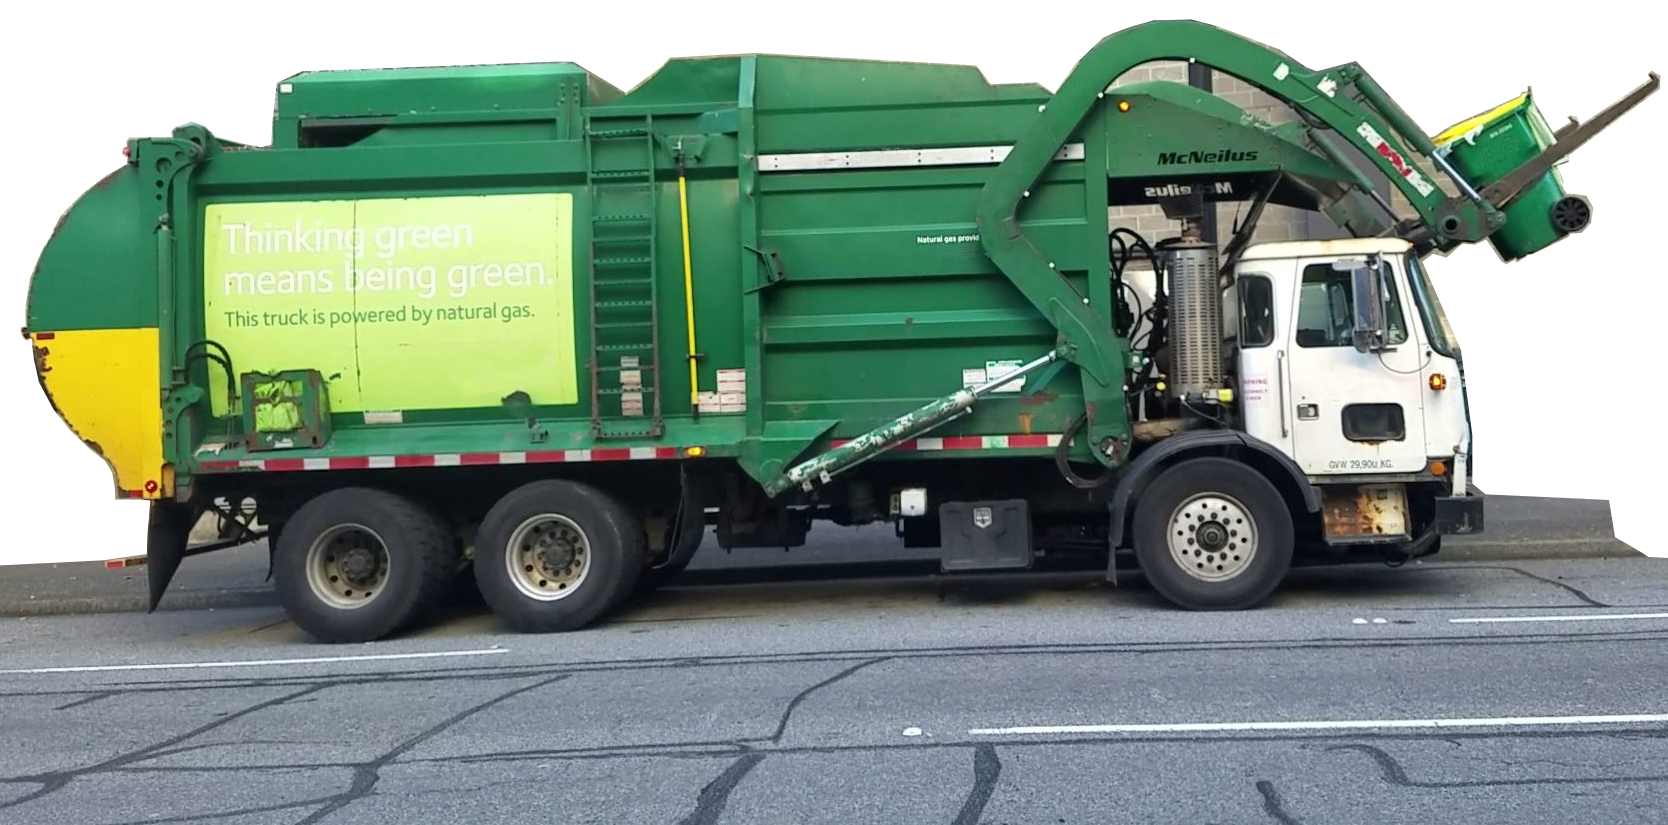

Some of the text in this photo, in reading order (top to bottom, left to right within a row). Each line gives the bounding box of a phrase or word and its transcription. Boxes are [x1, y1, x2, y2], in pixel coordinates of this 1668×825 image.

[1157, 149, 1259, 166] McNeilus
[222, 219, 473, 259] Thinking green
[917, 235, 943, 244] Natural
[222, 260, 555, 299] means being green.
[224, 302, 536, 329] This truck is powered by natural gas.
[1328, 460, 1347, 469] GVW
